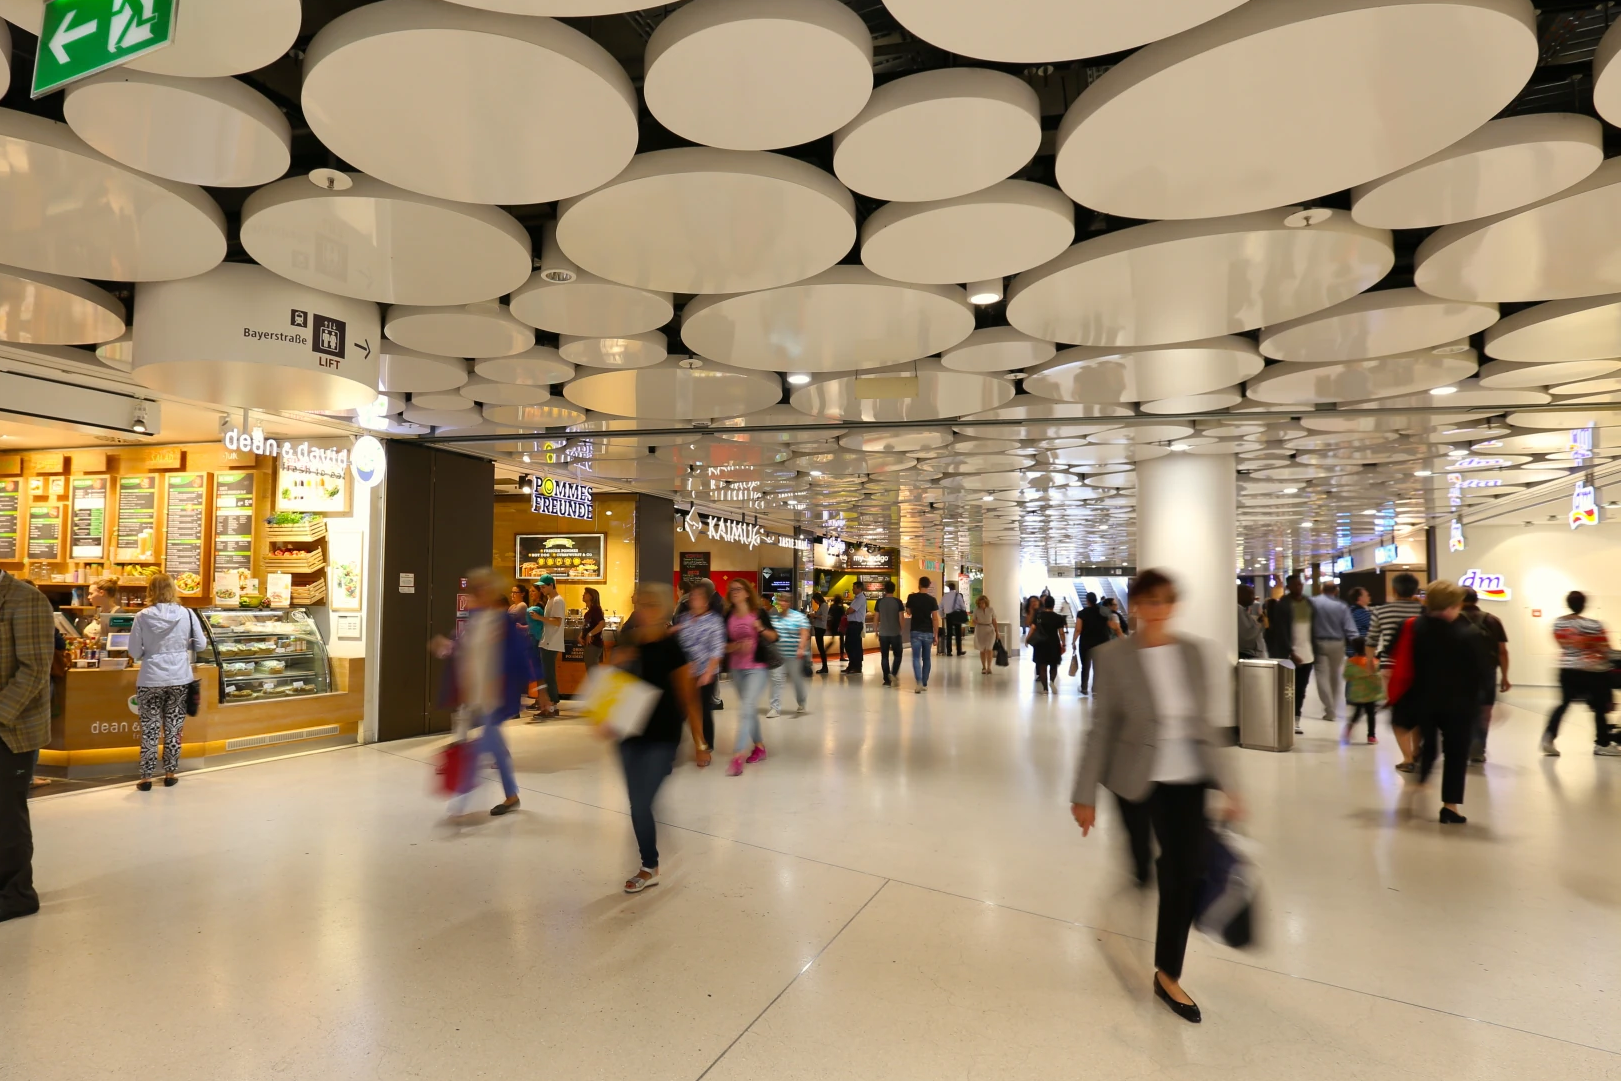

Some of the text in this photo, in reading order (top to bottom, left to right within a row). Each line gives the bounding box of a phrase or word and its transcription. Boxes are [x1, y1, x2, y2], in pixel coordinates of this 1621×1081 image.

[243, 327, 307, 344] Bayerstraße
[318, 356, 341, 370] LIFT
[225, 428, 348, 468] dean & david
[533, 476, 593, 502] POMMES
[532, 495, 593, 520] FREUNDE
[1462, 571, 1501, 589] dm
[90, 721, 140, 734] dean &
